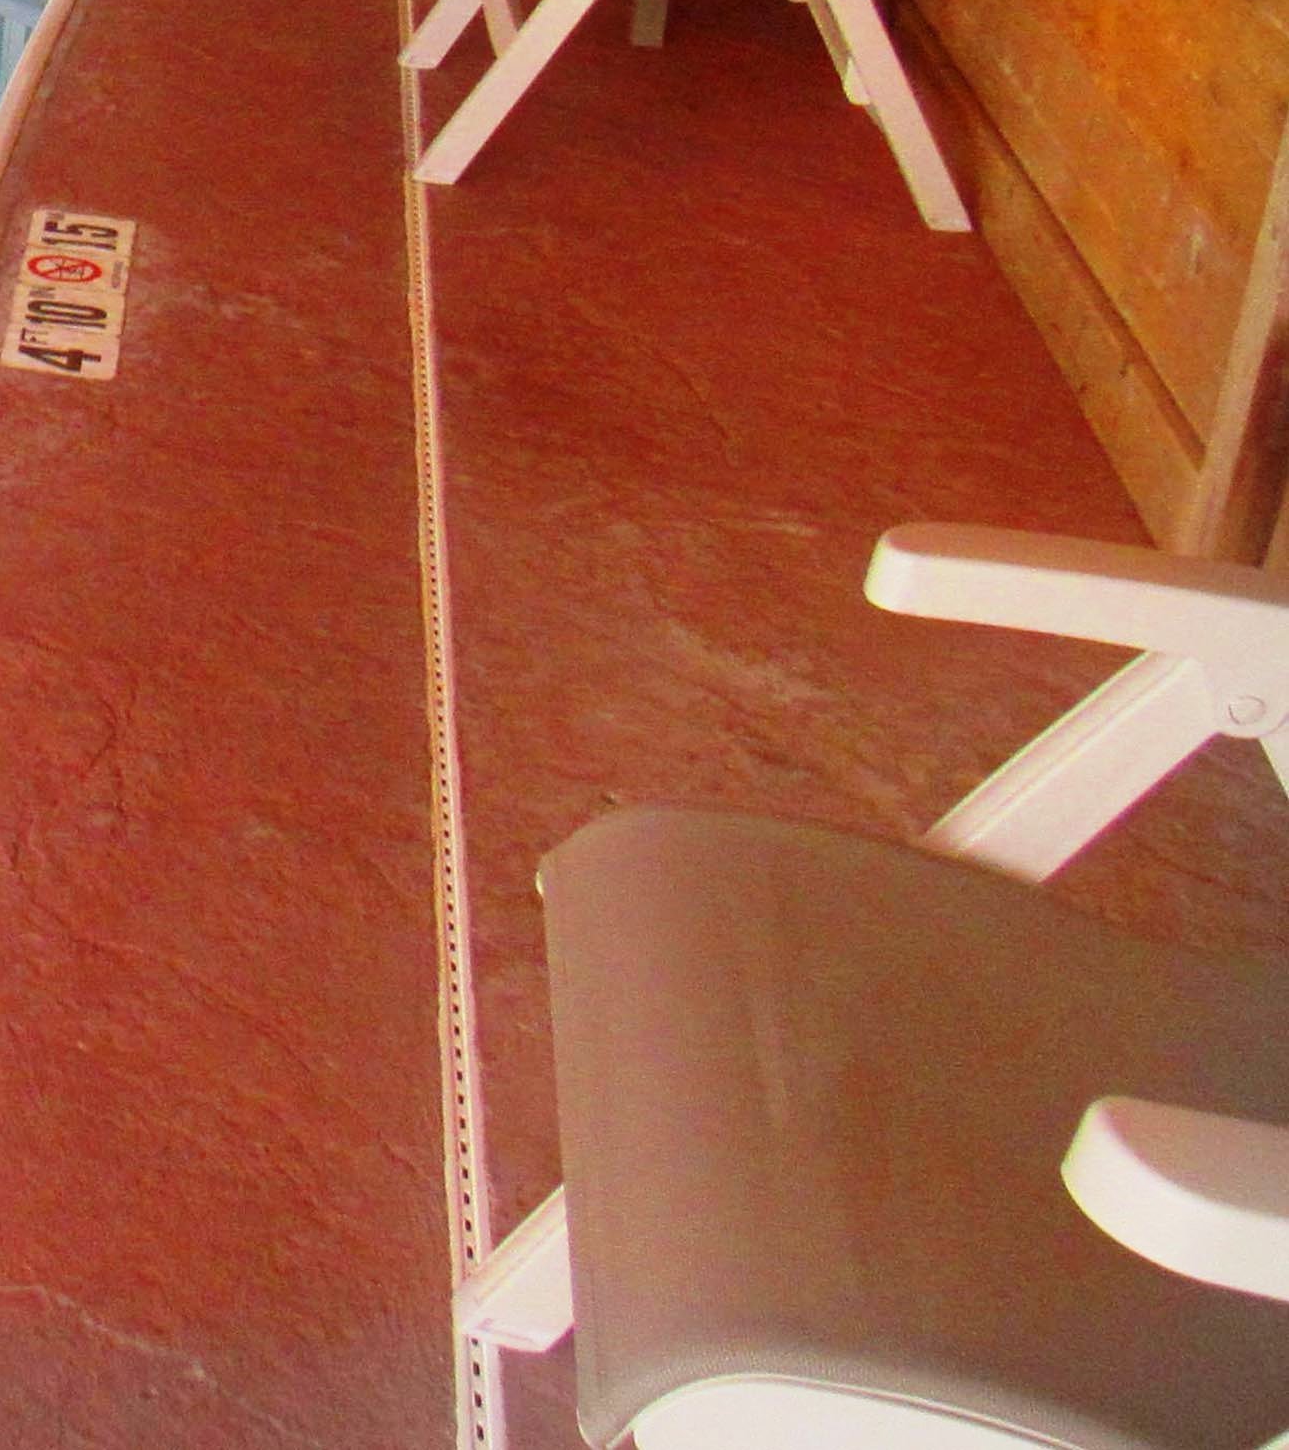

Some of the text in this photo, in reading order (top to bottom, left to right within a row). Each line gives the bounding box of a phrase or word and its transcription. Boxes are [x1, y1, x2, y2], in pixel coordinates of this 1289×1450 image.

[41, 221, 119, 251] 15
[25, 300, 108, 330] 10
[18, 343, 102, 373] 4
